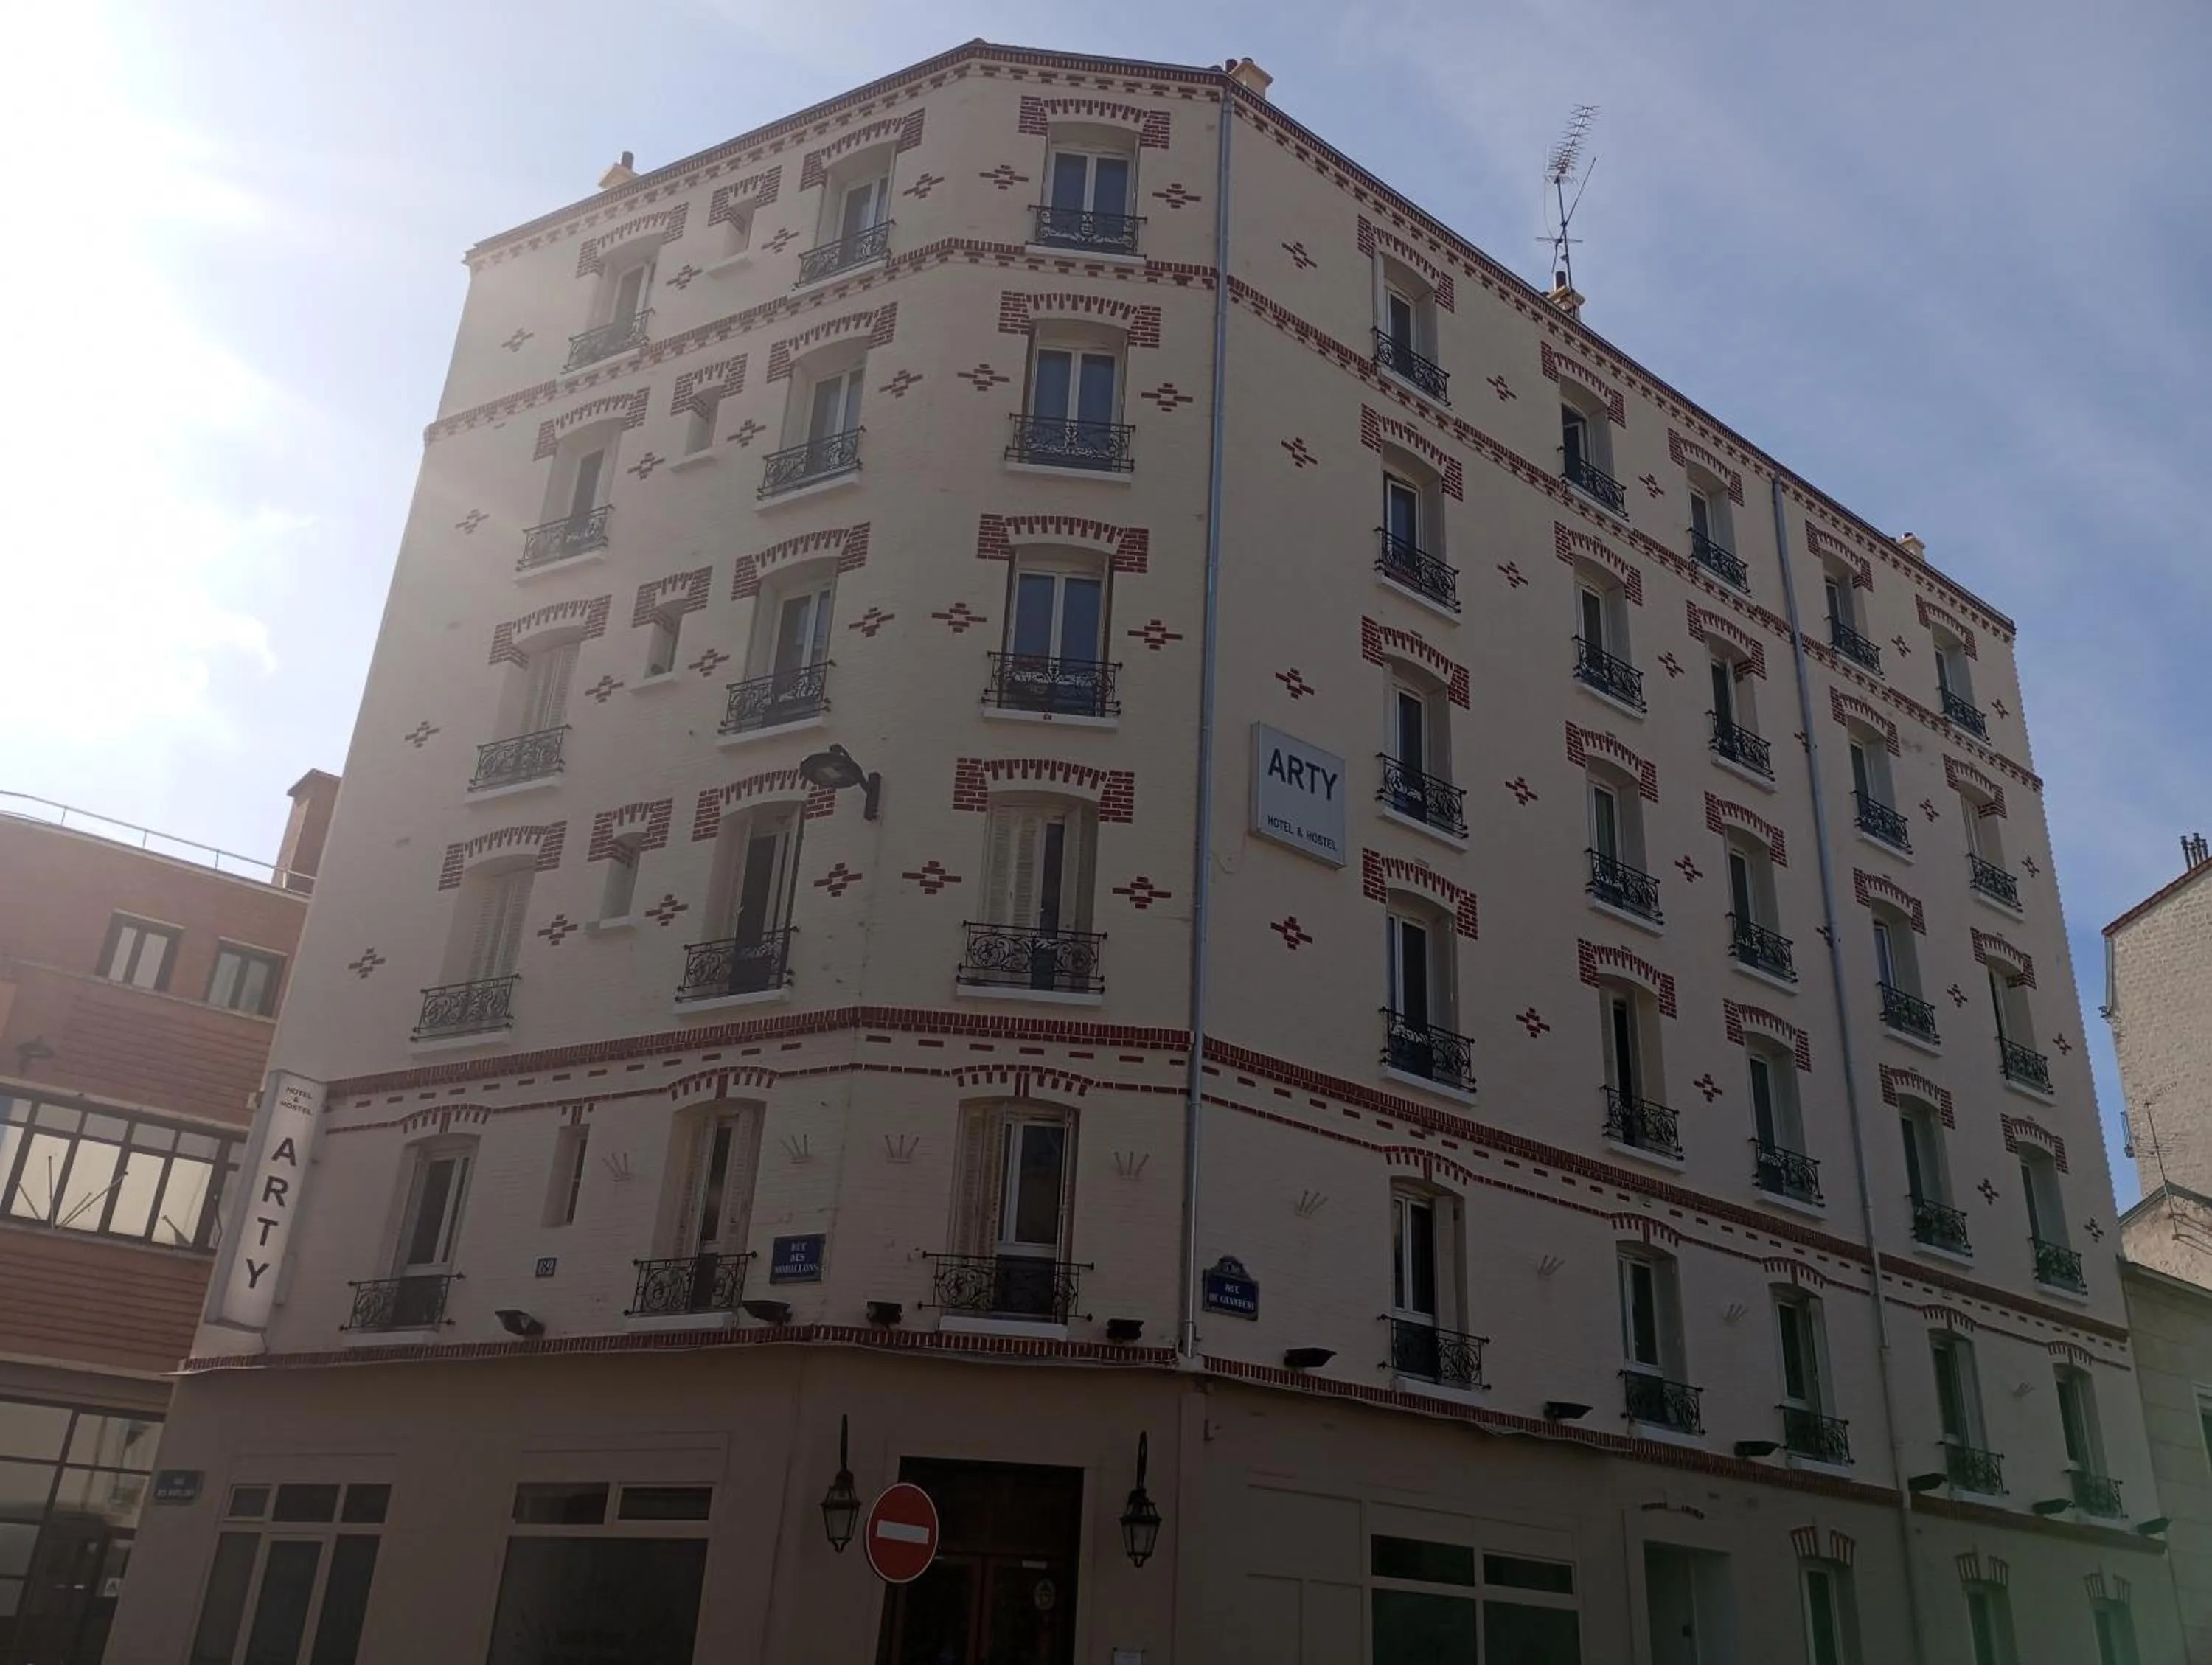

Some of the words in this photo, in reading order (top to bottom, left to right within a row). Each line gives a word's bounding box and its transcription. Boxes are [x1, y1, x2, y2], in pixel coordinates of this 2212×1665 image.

[1267, 748, 1338, 801] ARTY
[1267, 815, 1293, 834] HOTEL
[1297, 827, 1303, 838] &
[1307, 831, 1337, 850] HOSTEL
[286, 1085, 313, 1099] HOTEL
[280, 1100, 313, 1116] HOSTEL
[246, 1136, 296, 1289] ARTY
[791, 1242, 807, 1251] RUE
[790, 1253, 806, 1262] DES
[1225, 1284, 1240, 1294] RUE
